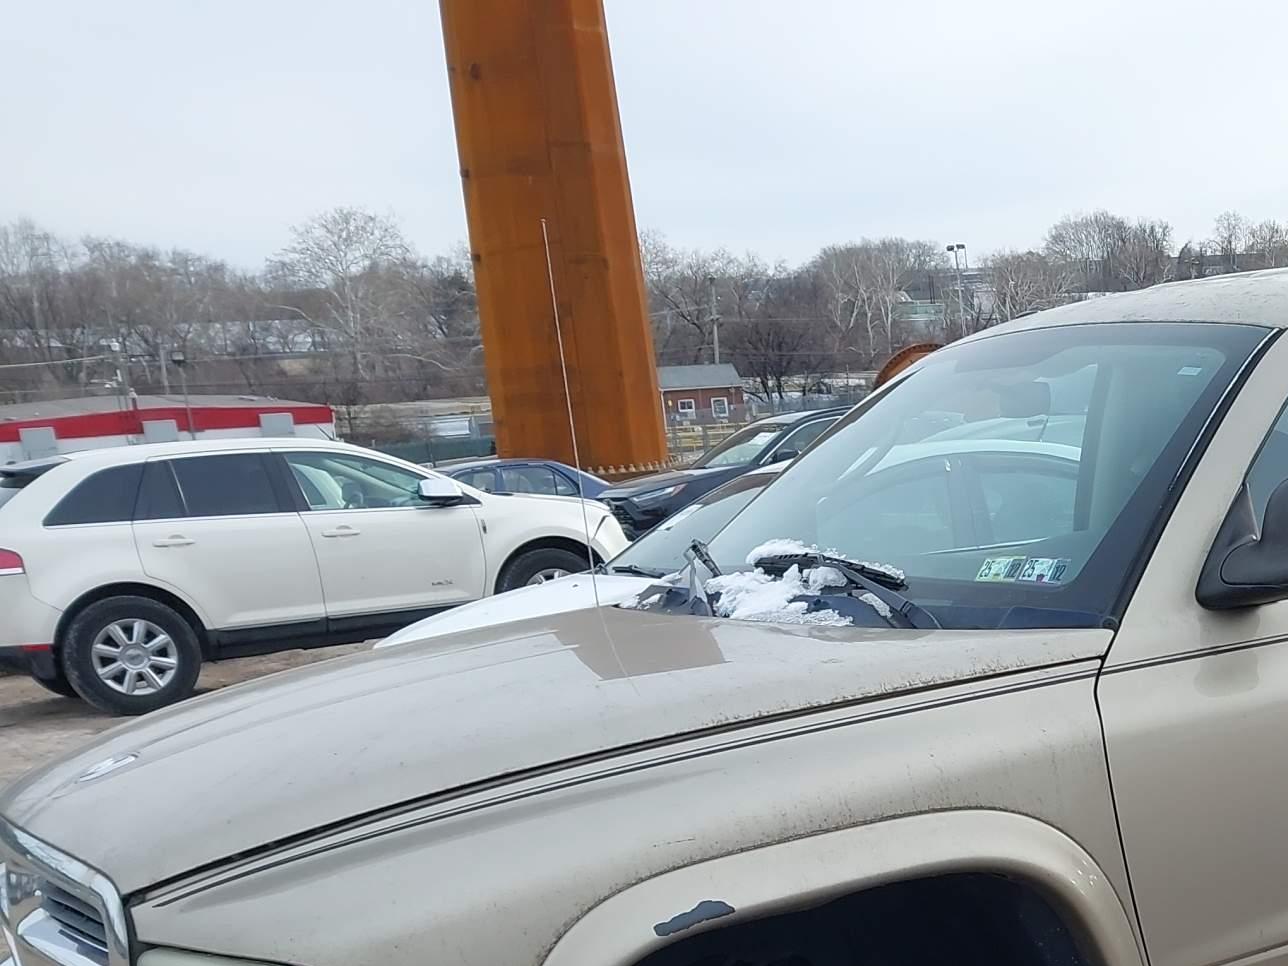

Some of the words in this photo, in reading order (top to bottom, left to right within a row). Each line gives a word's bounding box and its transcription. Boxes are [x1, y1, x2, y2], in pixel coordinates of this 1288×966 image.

[979, 560, 996, 577] 25
[1022, 560, 1040, 577] 25
[1052, 564, 1067, 580] 12
